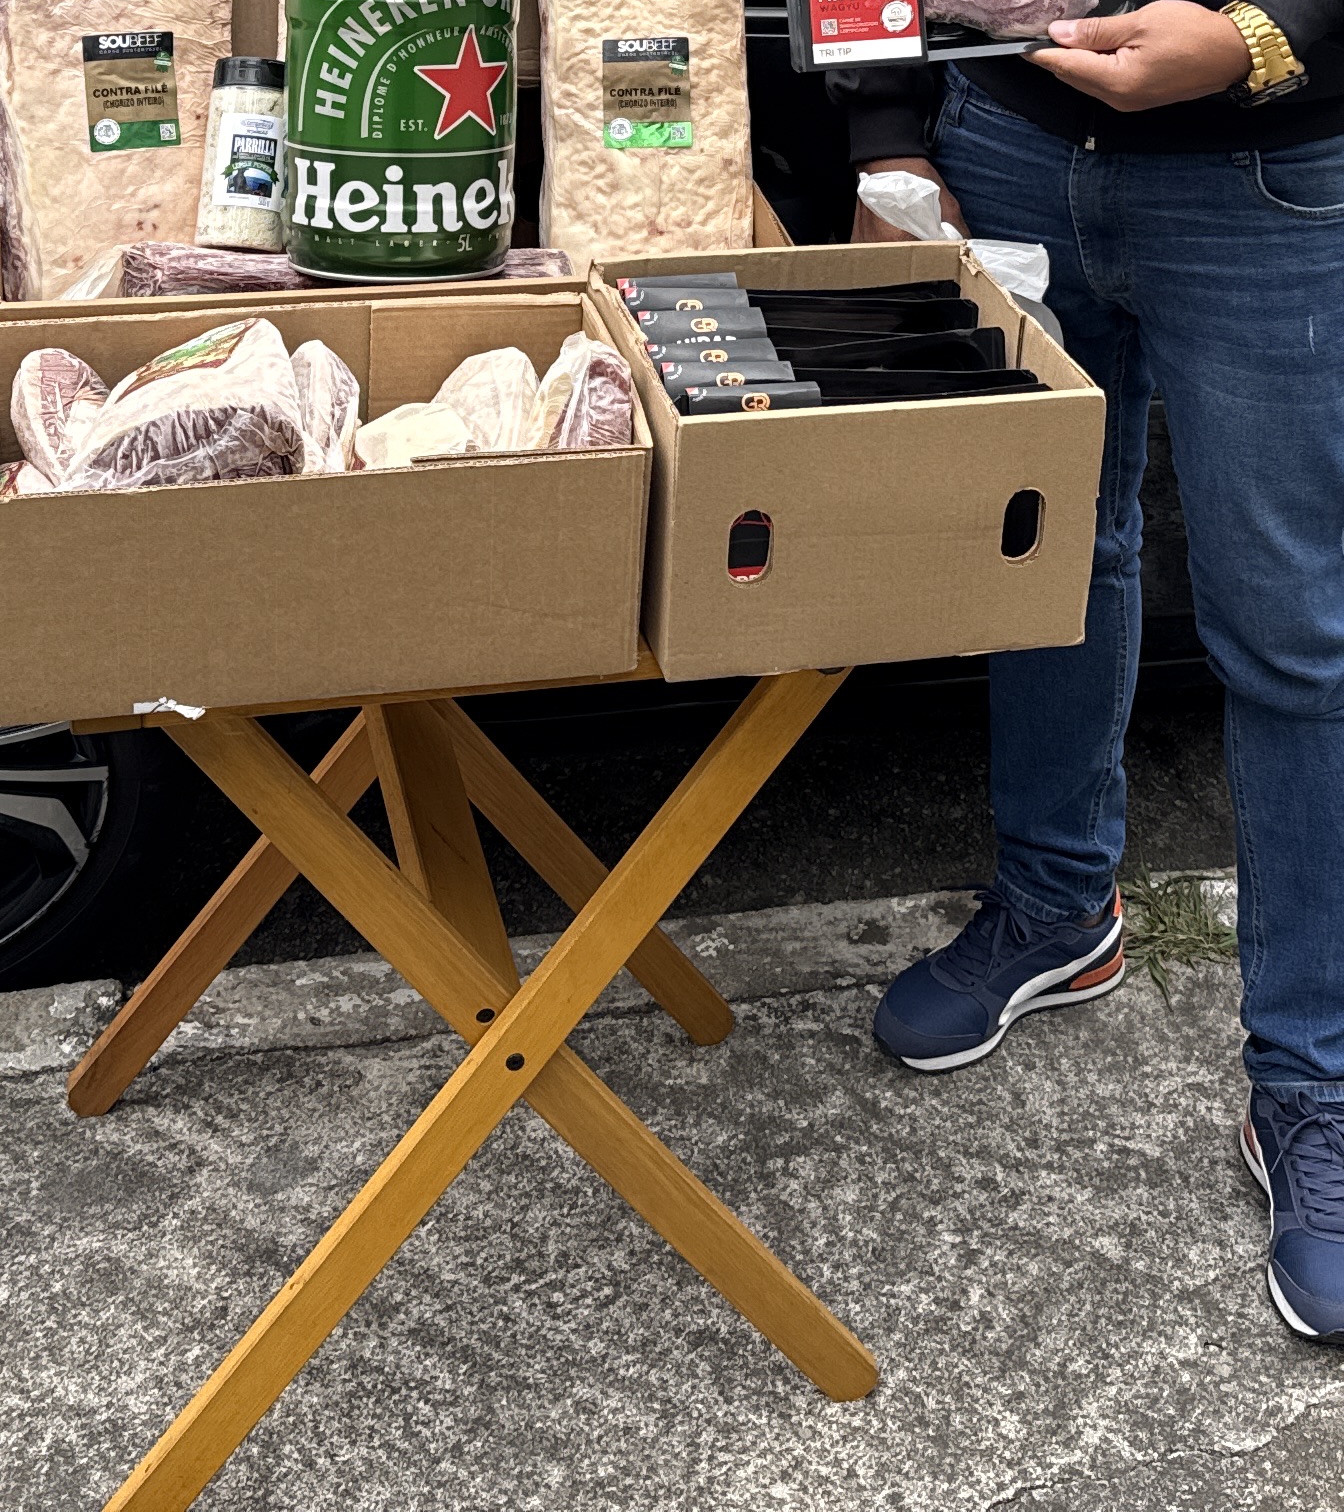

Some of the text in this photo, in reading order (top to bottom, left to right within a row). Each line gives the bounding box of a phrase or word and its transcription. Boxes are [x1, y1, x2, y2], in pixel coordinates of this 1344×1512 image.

[820, 3, 860, 12] WAGYU
[98, 33, 163, 49] SOUBEEF
[617, 39, 678, 53] SOUBEEF
[819, 48, 852, 57] TRI TIP
[93, 82, 169, 98] CONTRA FILÉ
[372, 76, 390, 139] DIPLOME
[386, 26, 460, 72] D'HONNEUR
[609, 85, 682, 98] CONTRA FILÉ
[400, 119, 428, 132] EST.
[234, 137, 275, 156] PARRILLA
[457, 234, 473, 252] 5L
